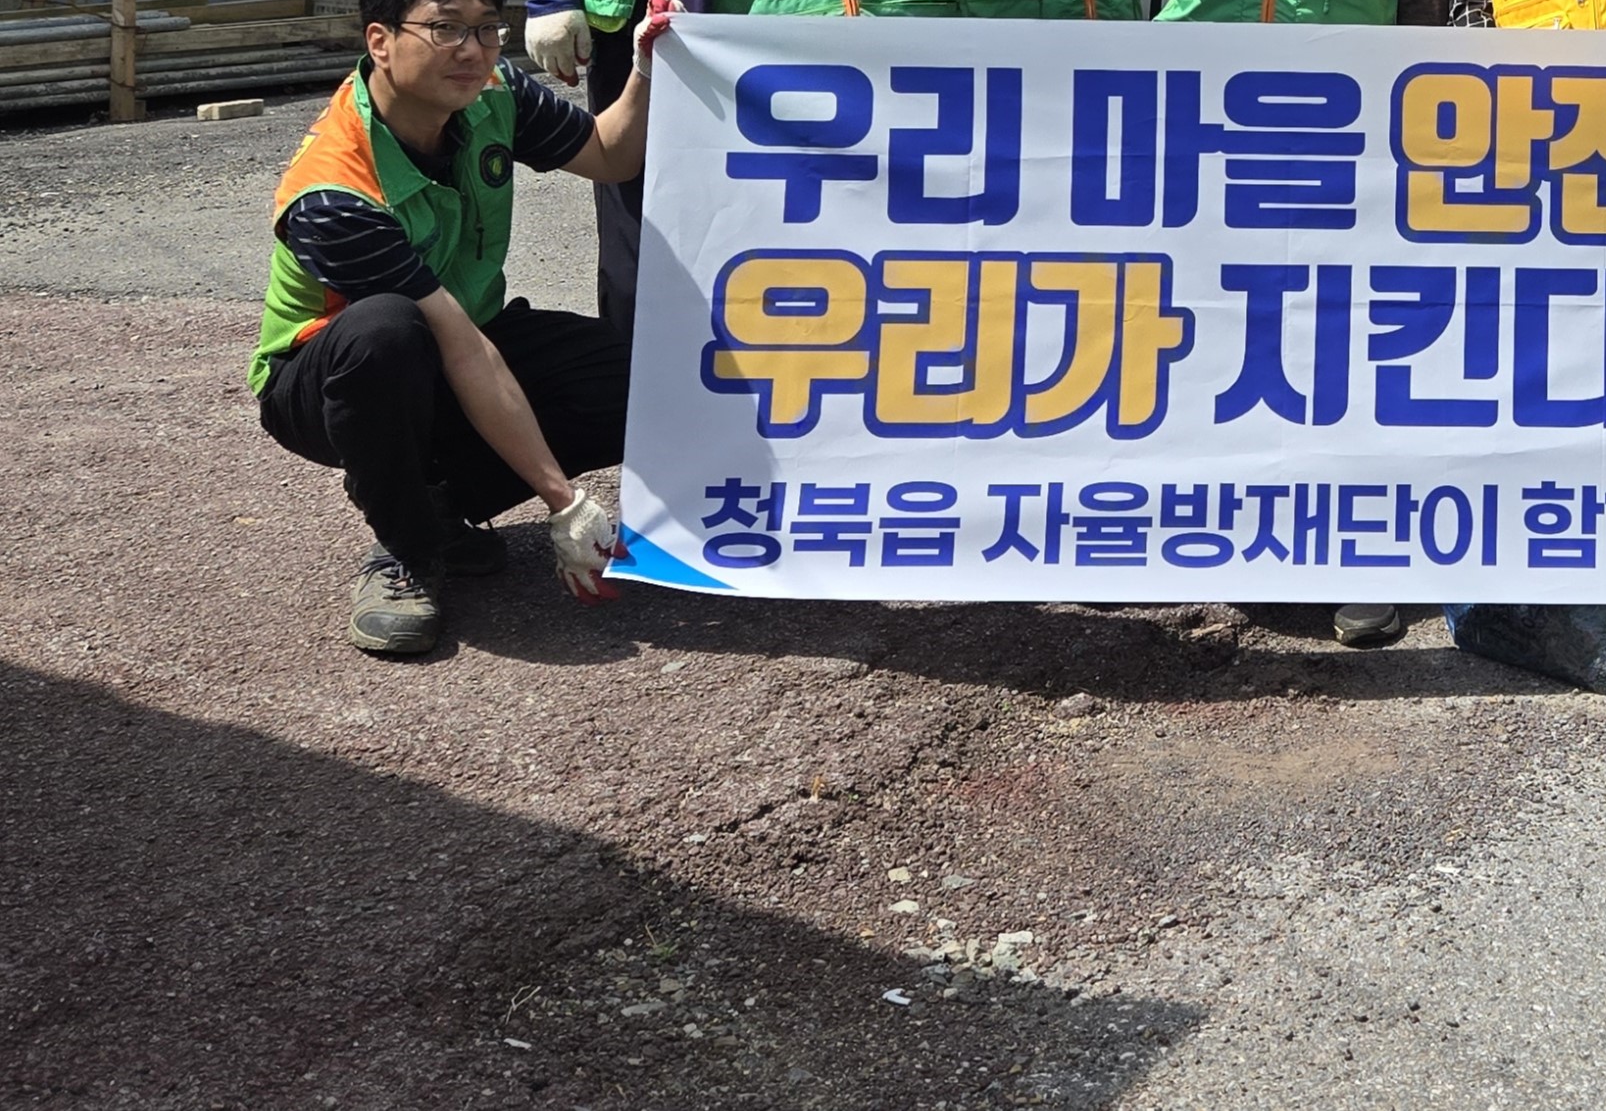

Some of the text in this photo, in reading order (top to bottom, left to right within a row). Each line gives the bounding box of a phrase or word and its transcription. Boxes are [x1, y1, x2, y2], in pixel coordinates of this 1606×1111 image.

[725, 64, 1022, 227] 우리
[1070, 69, 1365, 230] 마을
[700, 248, 1195, 440] 우리가
[700, 477, 961, 568] 청북읍
[981, 480, 1498, 568] 자율방재단이
